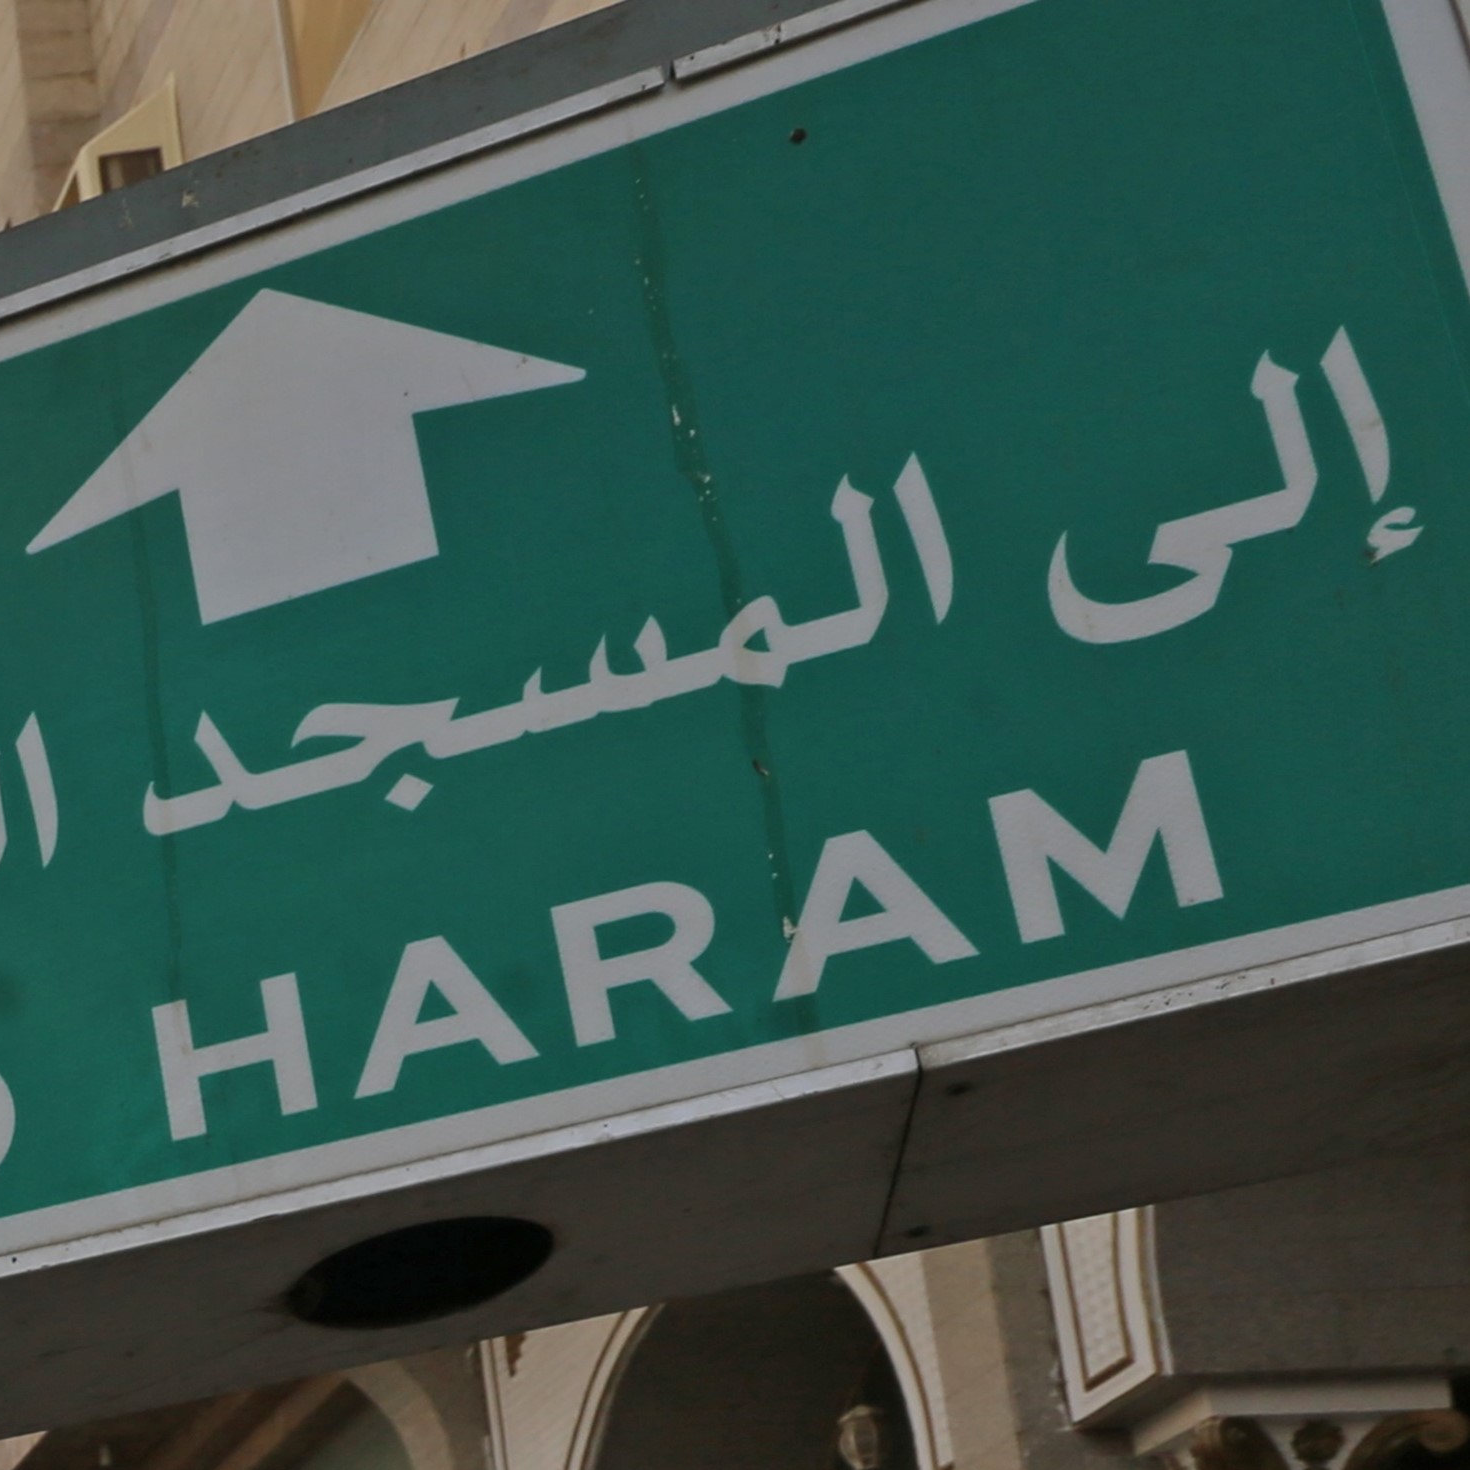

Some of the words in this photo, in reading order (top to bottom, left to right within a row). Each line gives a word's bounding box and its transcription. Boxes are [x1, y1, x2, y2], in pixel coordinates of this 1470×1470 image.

[142, 451, 955, 837] المسجد
[1046, 324, 1424, 645] إلى
[150, 749, 1224, 1141] HARAM
